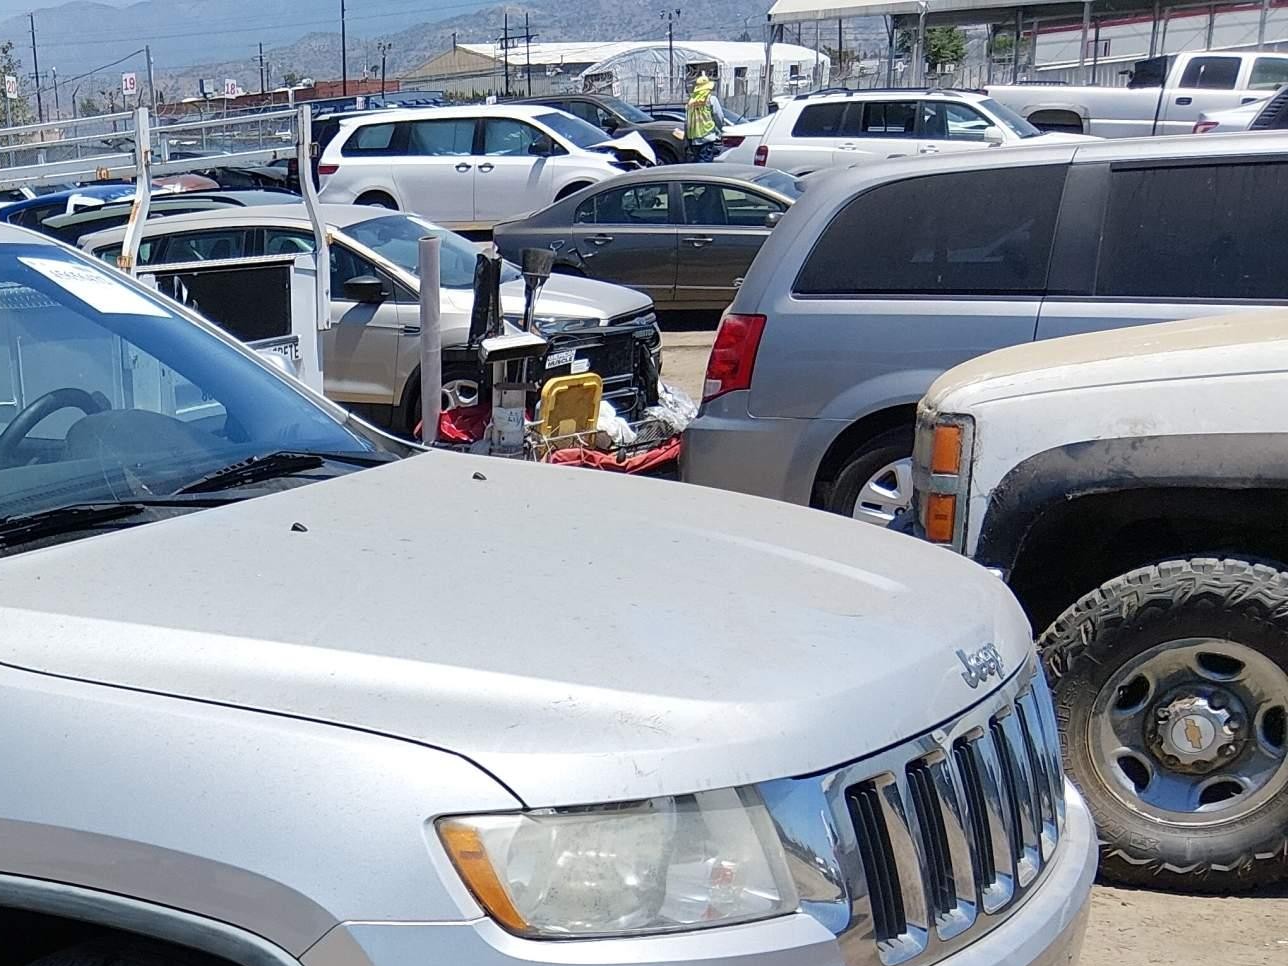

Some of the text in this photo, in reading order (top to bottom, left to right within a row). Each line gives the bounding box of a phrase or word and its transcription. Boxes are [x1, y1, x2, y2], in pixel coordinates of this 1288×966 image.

[7, 80, 16, 94] 20
[123, 77, 135, 90] 19
[225, 83, 236, 95] 18
[955, 642, 1005, 689] Jeep
